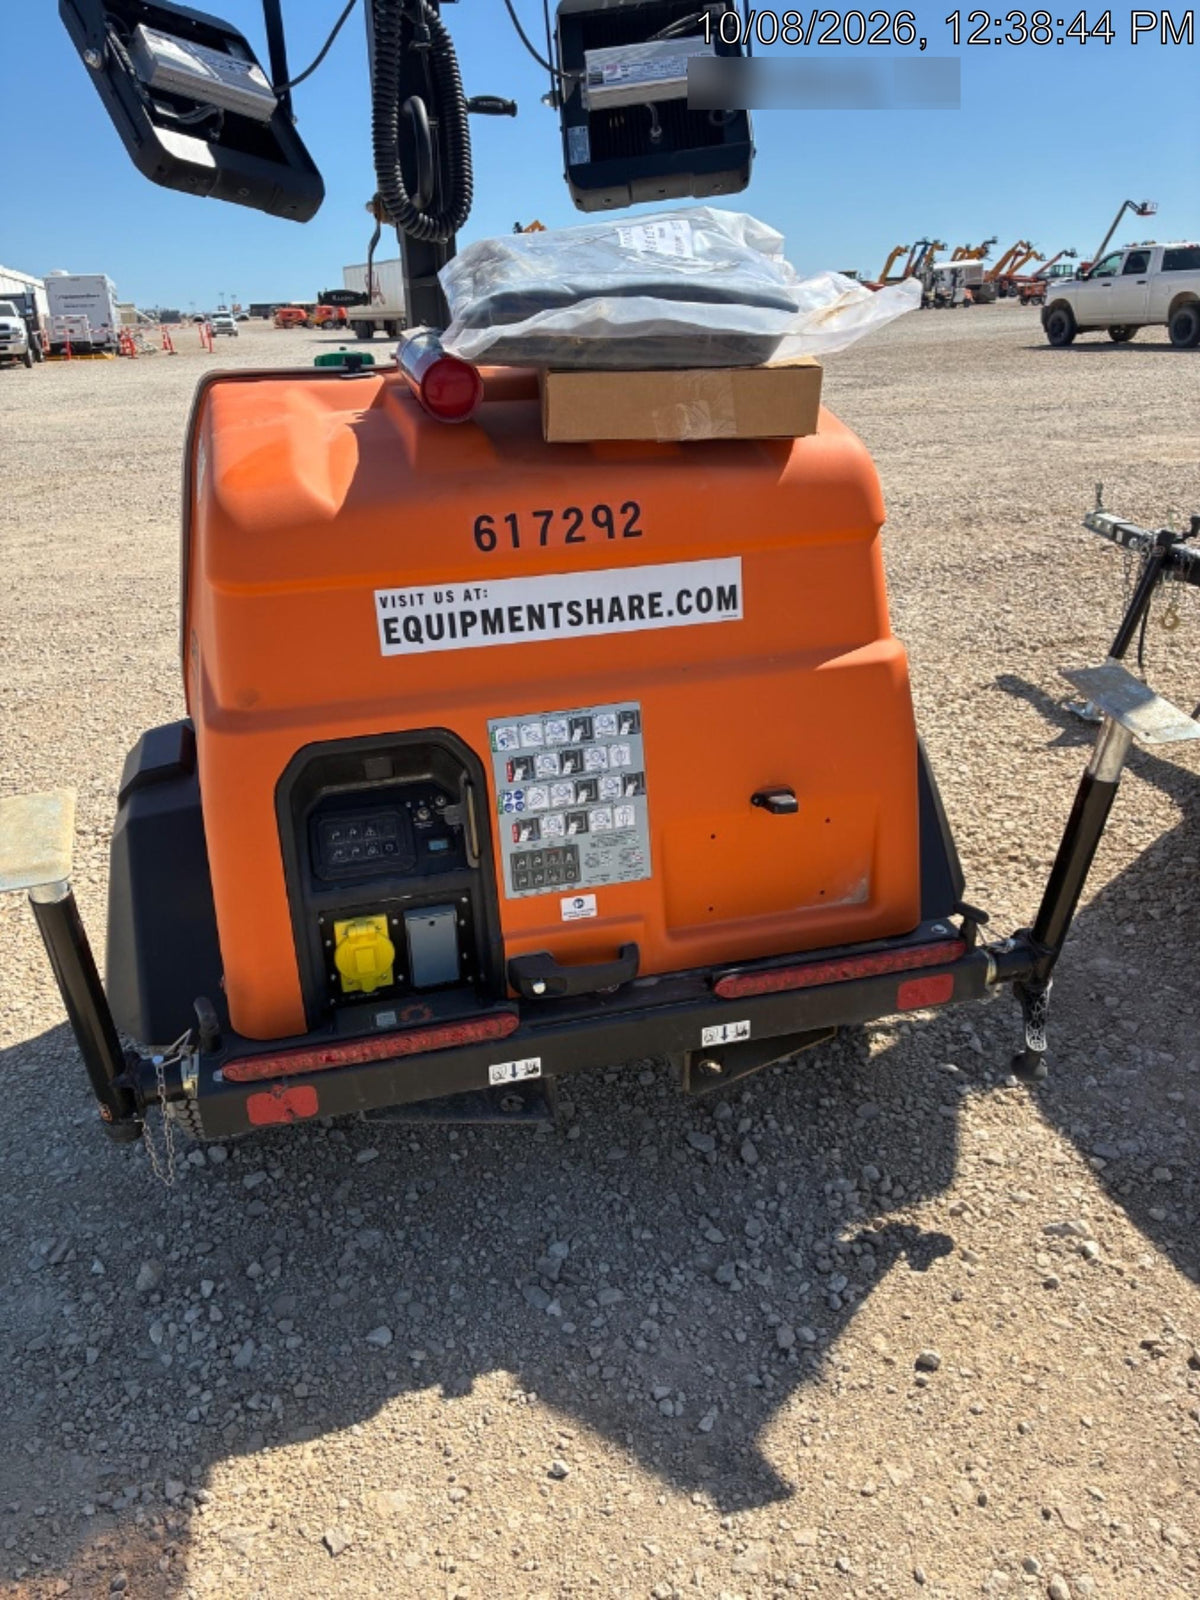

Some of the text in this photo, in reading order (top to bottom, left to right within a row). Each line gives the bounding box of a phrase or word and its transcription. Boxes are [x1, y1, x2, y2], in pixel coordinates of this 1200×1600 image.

[473, 501, 643, 552] 617292
[379, 588, 488, 609] VISIT US AT:
[382, 584, 739, 645] EQUIPMENTSHARE.COM
